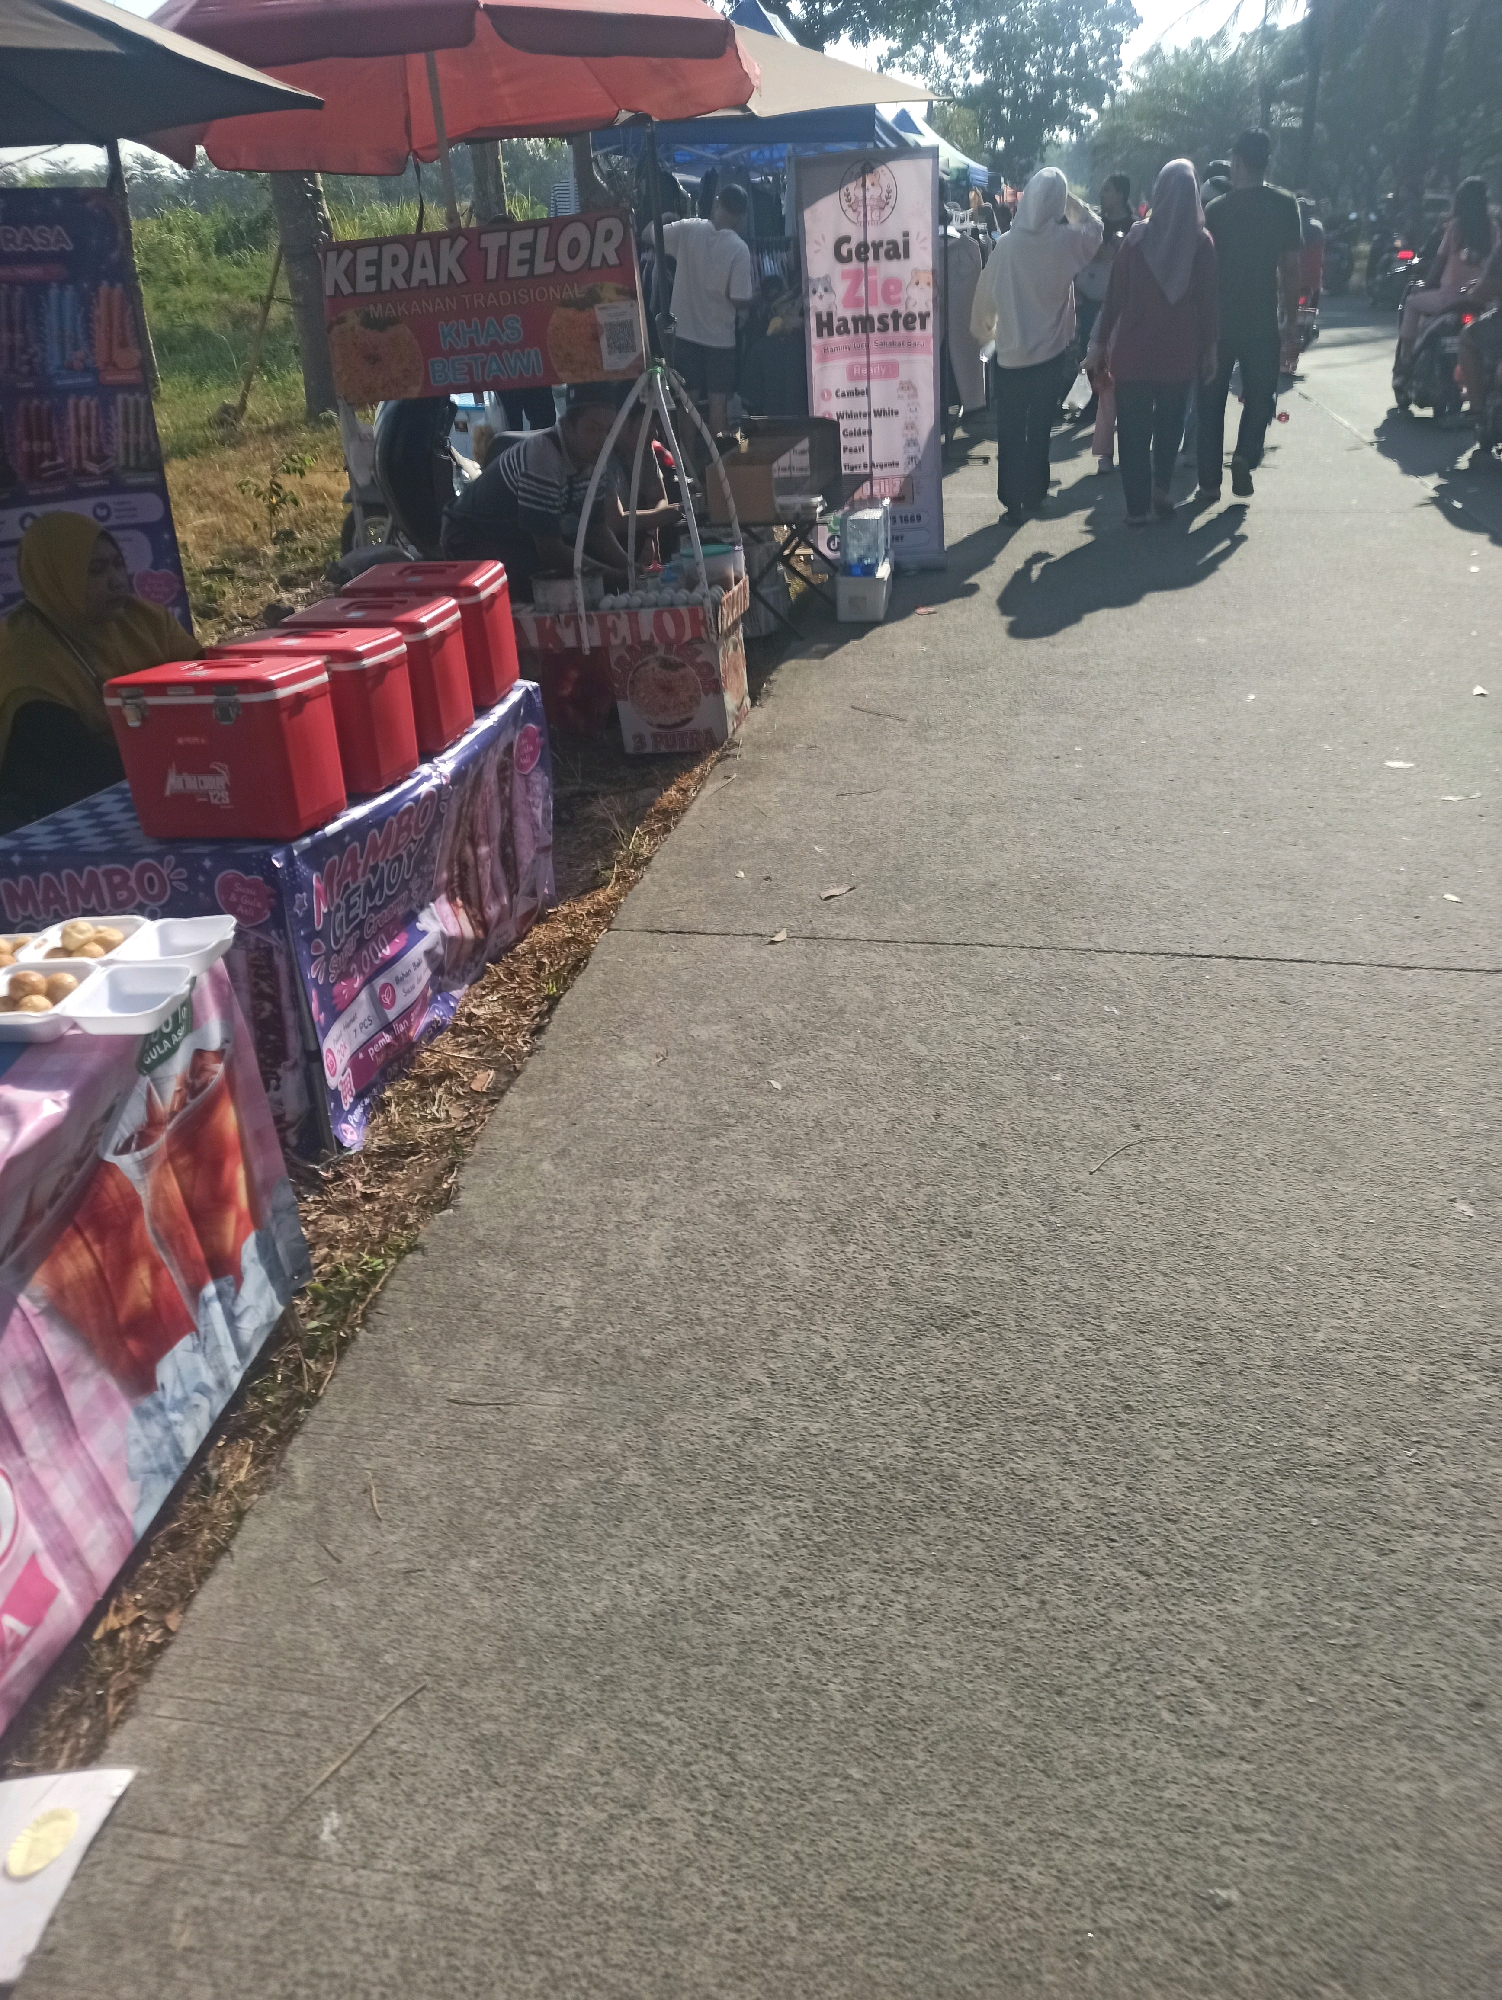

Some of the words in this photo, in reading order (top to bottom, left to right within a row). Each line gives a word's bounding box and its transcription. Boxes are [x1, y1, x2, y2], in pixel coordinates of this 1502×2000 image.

[0, 225, 74, 251] RASA
[833, 231, 910, 264] Gerai
[325, 235, 470, 296] KERAK
[480, 217, 625, 280] TELOR
[368, 295, 457, 319] MAKANAN
[461, 283, 586, 311] TRADISIONAL
[841, 267, 903, 309] Zie
[438, 313, 524, 350] KHAS
[815, 309, 931, 338] Hamster
[428, 347, 544, 387] BETAWI
[853, 364, 887, 377] Ready
[873, 407, 900, 418] White
[842, 428, 872, 438] Golden
[843, 443, 865, 454] Pearl
[843, 463, 862, 471] Tiger
[899, 513, 922, 523] 1669
[632, 732, 646, 753] 3
[650, 727, 719, 753] PUTRA
[313, 787, 438, 931] MAMBO
[0, 858, 170, 922] MAMBO
[330, 834, 425, 951] GEMOY
[329, 930, 360, 984] Super
[359, 1015, 373, 1032] PCS
[143, 1039, 171, 1065] GULA
